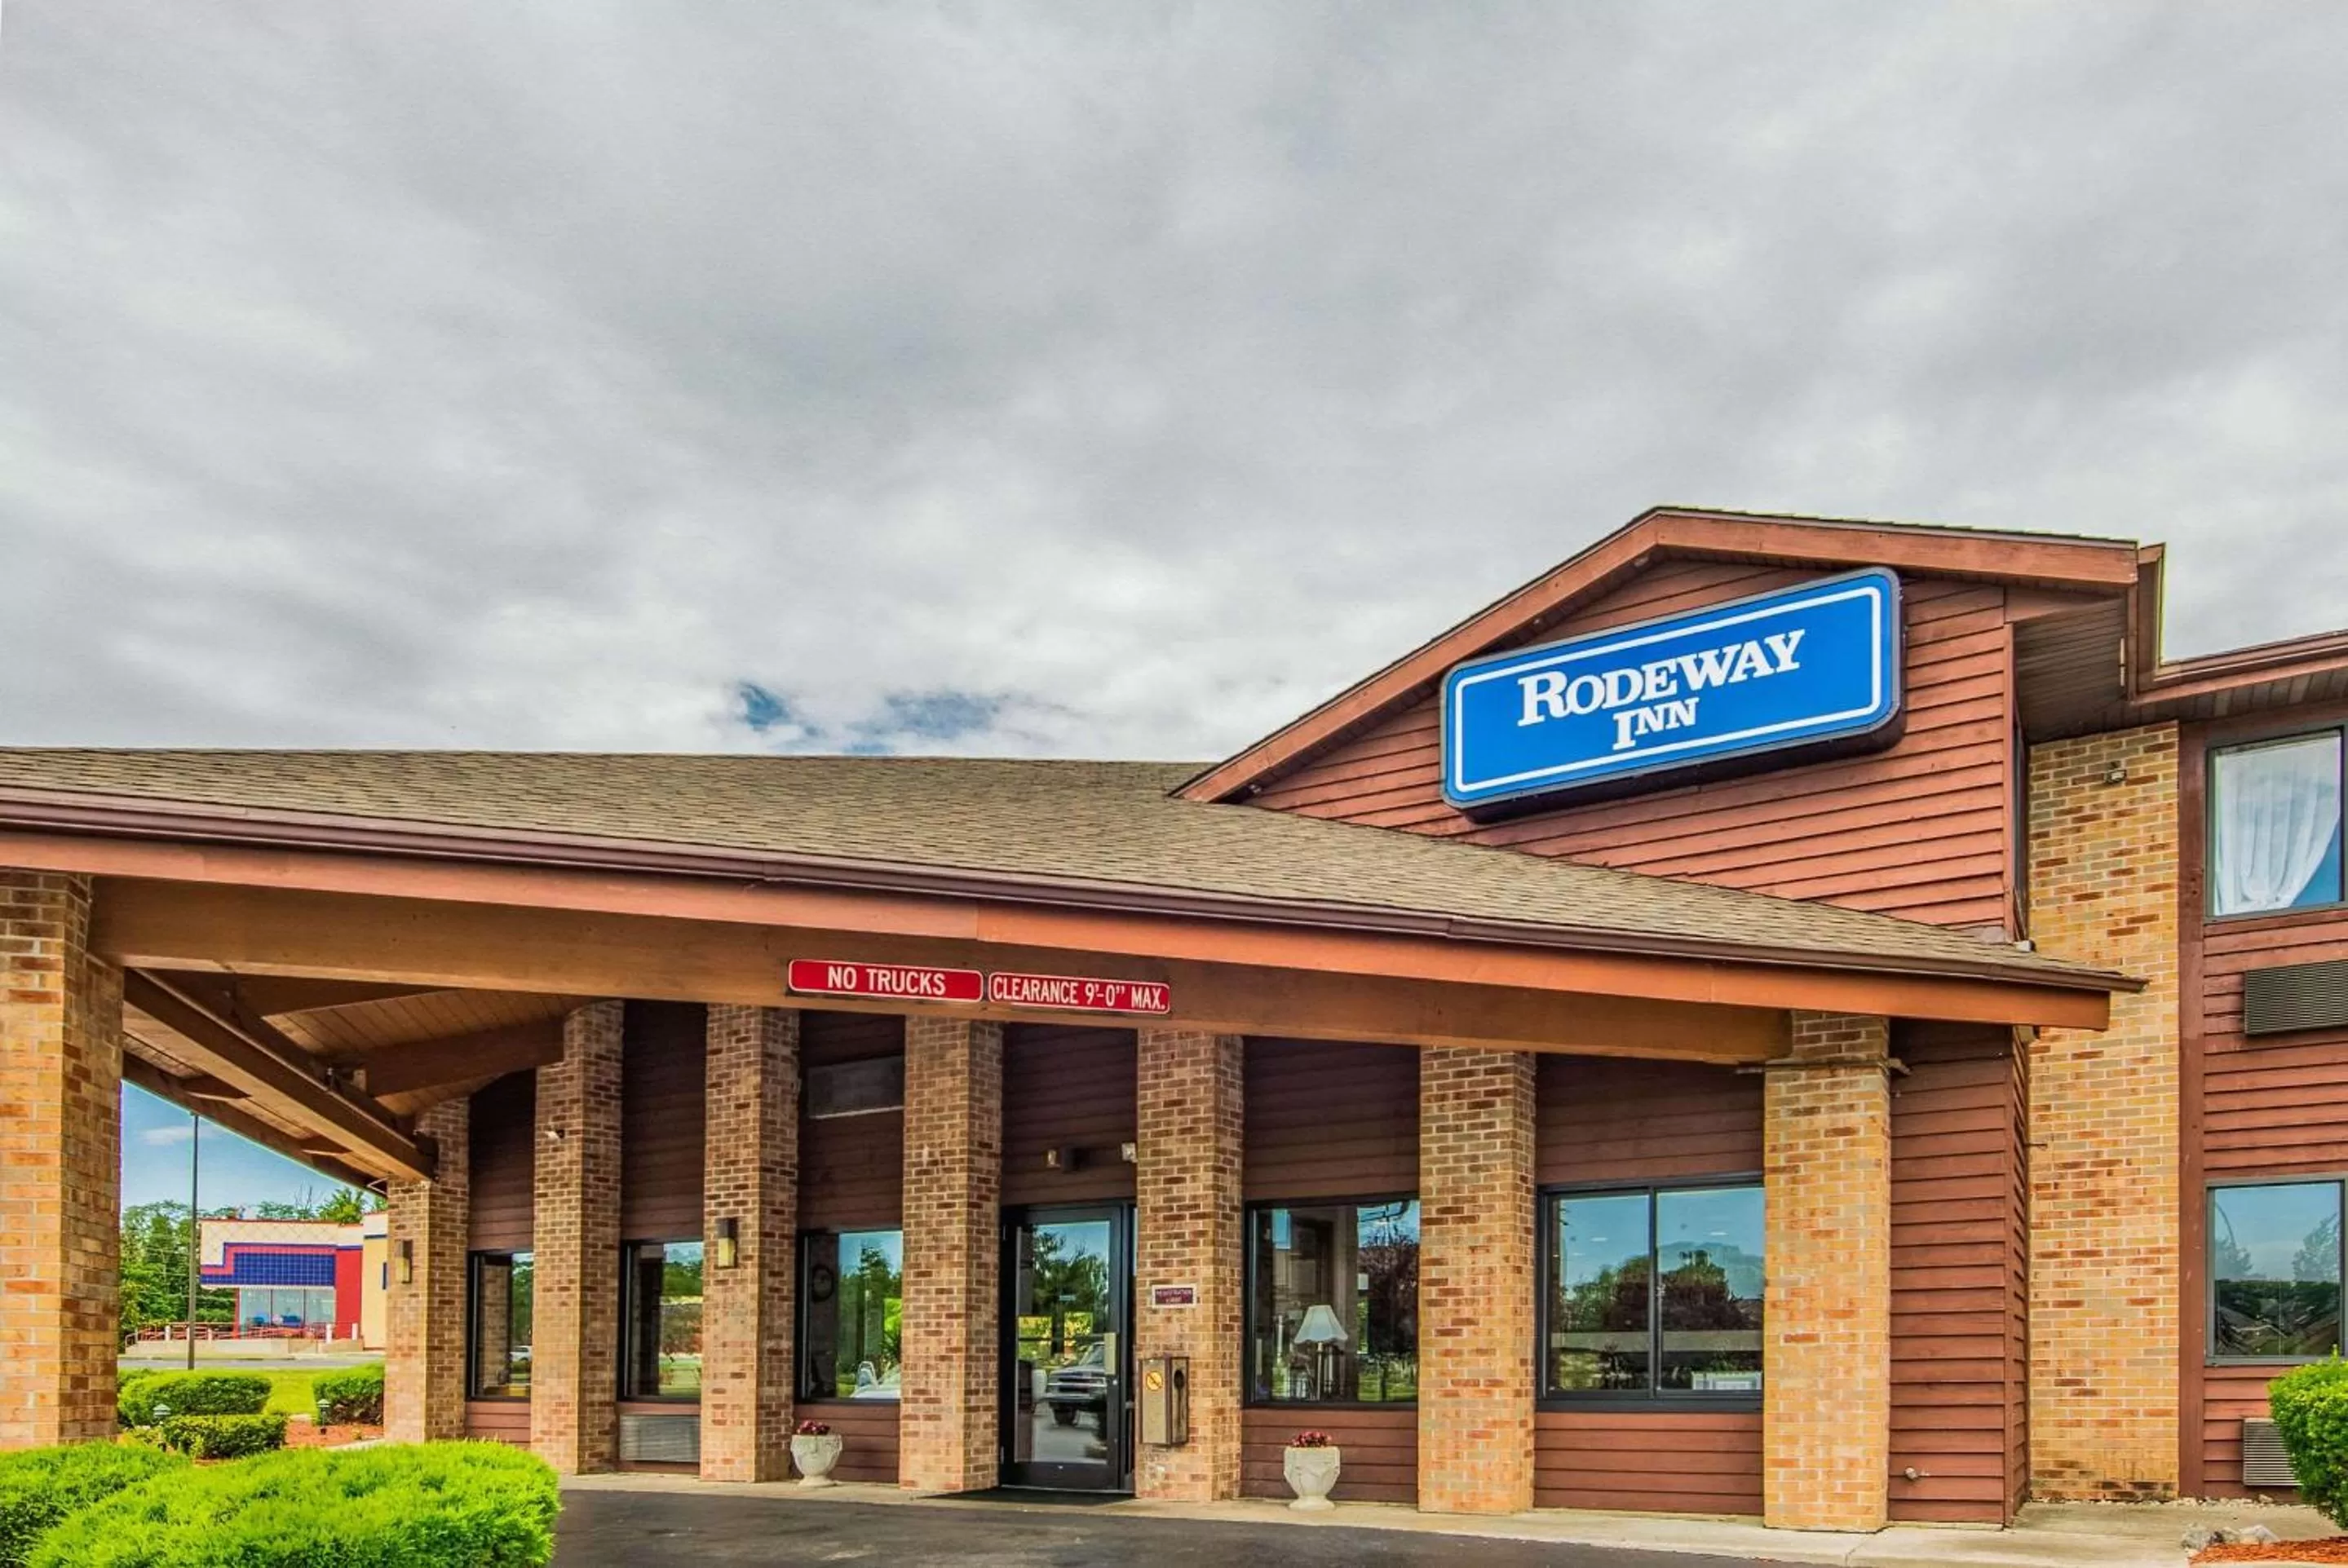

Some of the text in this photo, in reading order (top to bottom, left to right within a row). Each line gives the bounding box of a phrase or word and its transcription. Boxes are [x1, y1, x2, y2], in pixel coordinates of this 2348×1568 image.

[1517, 629, 1806, 727] RODEWAY
[1612, 697, 1700, 750] INN
[827, 966, 947, 996] NO TRUCKS
[993, 976, 1079, 1004] CLEARANCE
[1130, 986, 1166, 1010] MAX.
